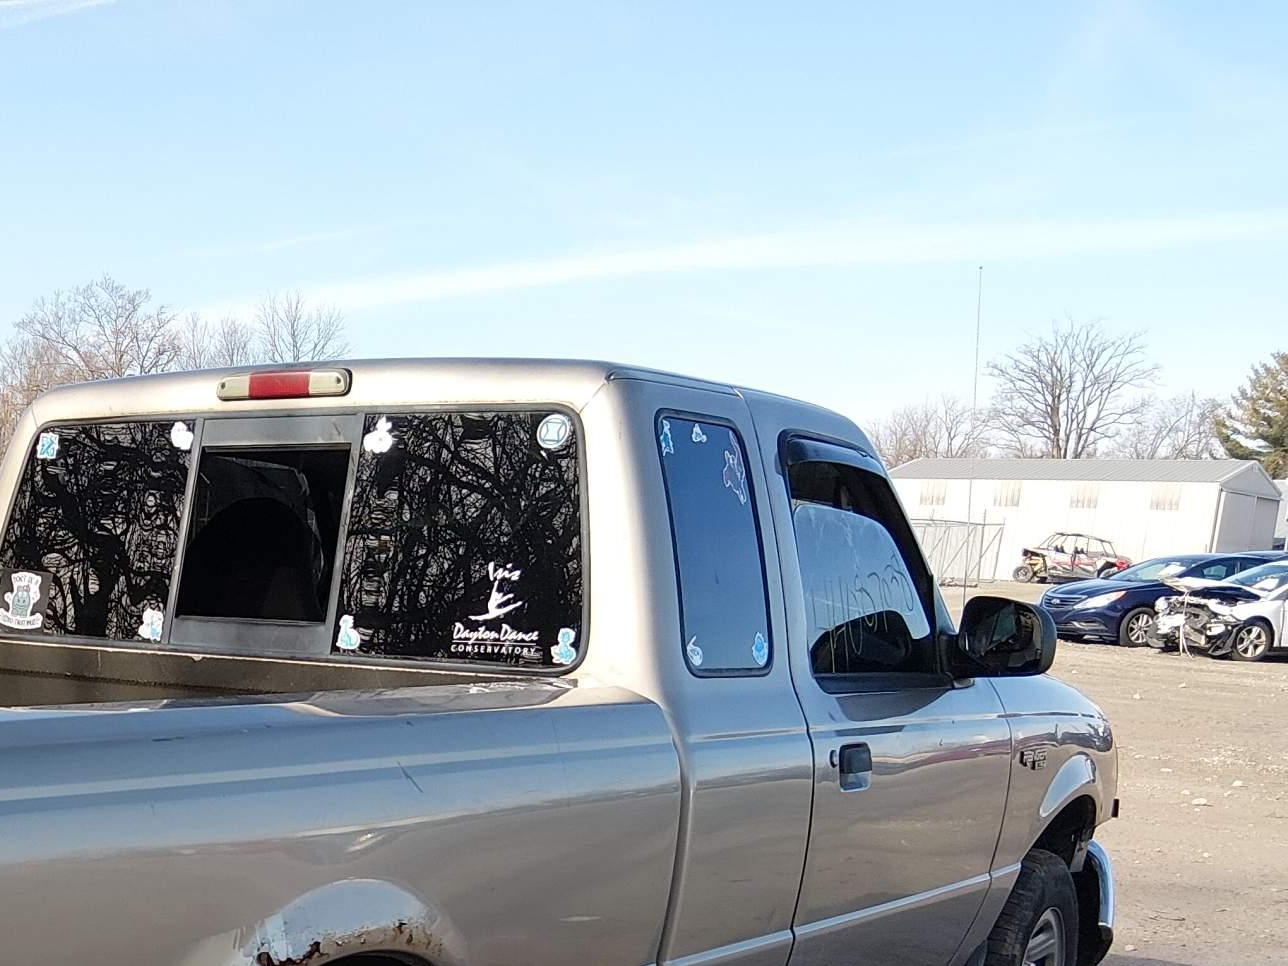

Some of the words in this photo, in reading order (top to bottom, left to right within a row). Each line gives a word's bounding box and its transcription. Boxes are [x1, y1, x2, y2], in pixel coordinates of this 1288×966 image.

[453, 622, 499, 644] Dayton
[500, 623, 539, 641] Dance
[451, 644, 536, 656] CONSERVATORY
